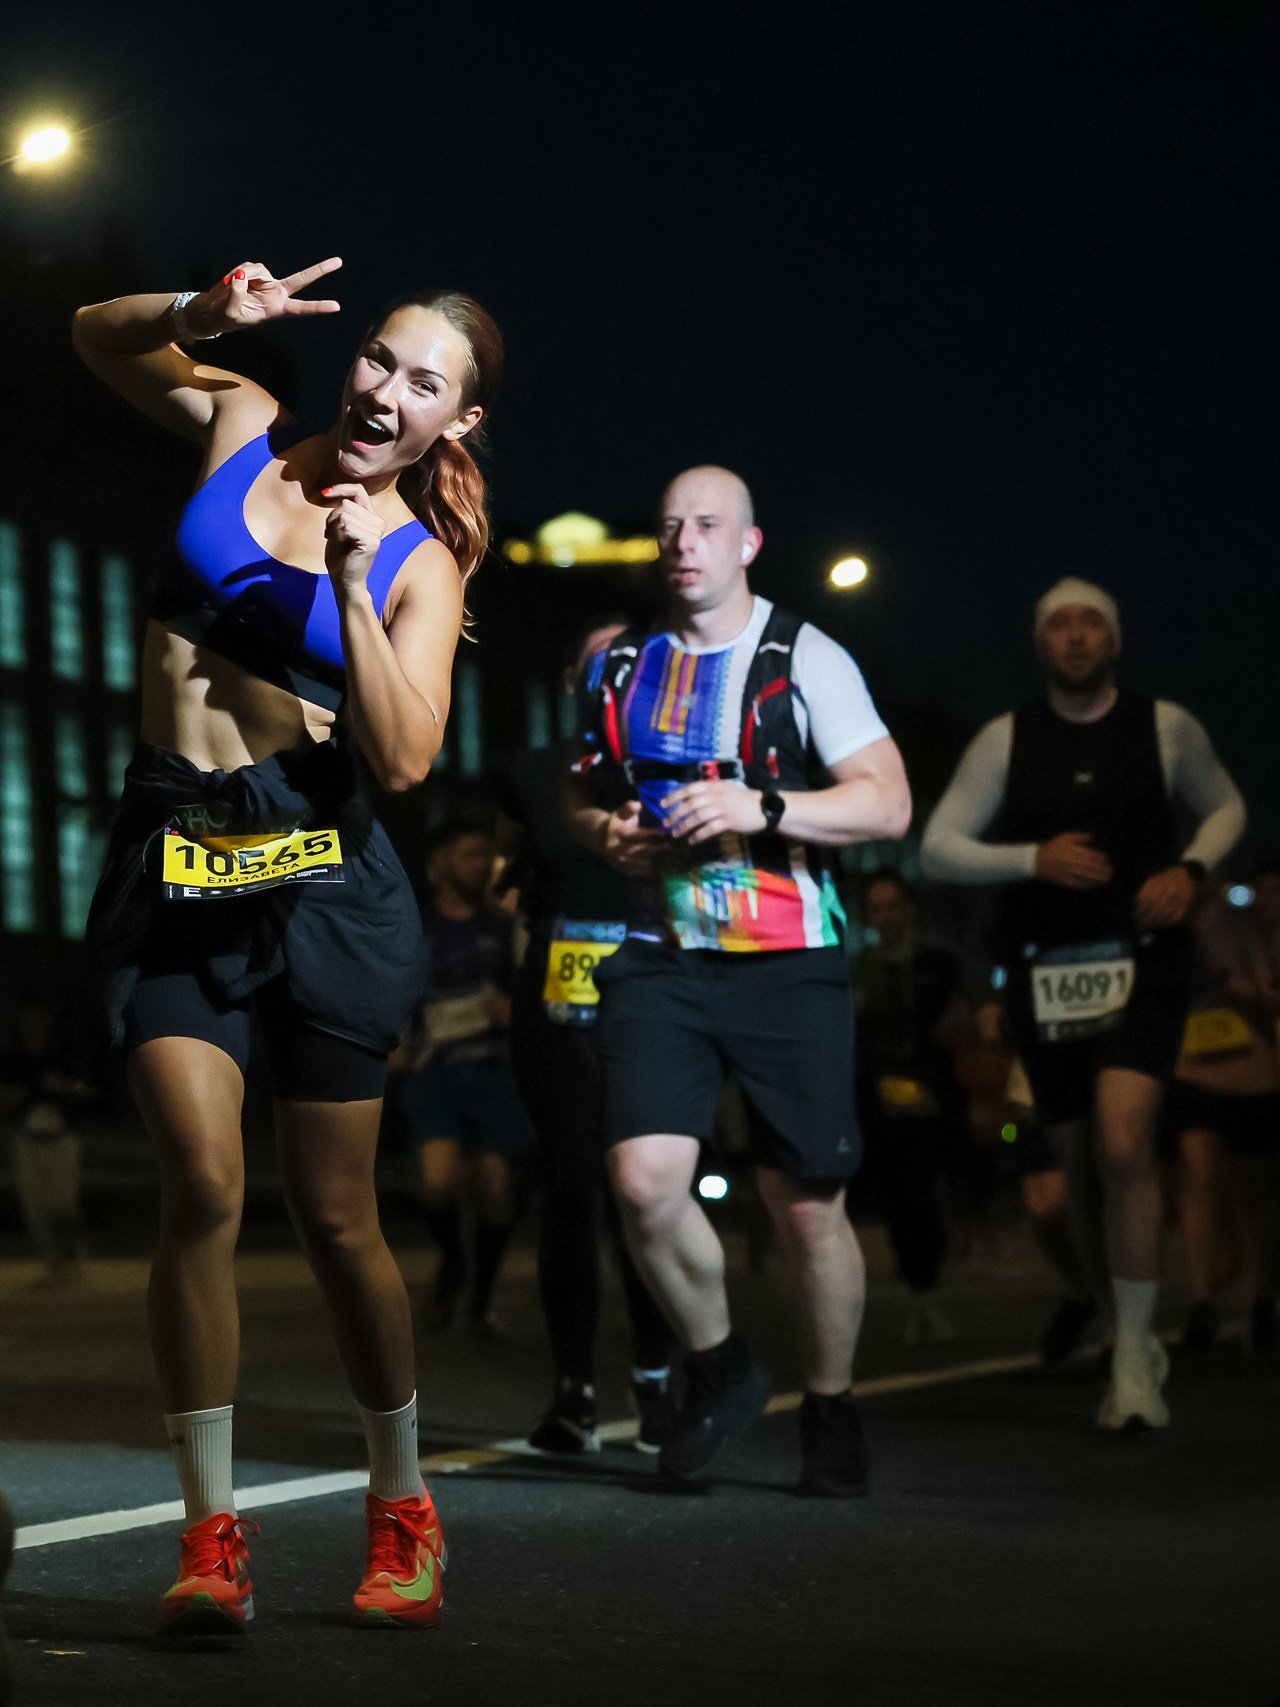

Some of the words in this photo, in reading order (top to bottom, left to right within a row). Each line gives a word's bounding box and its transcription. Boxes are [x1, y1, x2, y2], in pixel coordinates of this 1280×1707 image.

[175, 833, 333, 876] 10565
[207, 862, 300, 884] ЕЛИЗАВЕТА
[1040, 969, 1128, 1004] 16091
